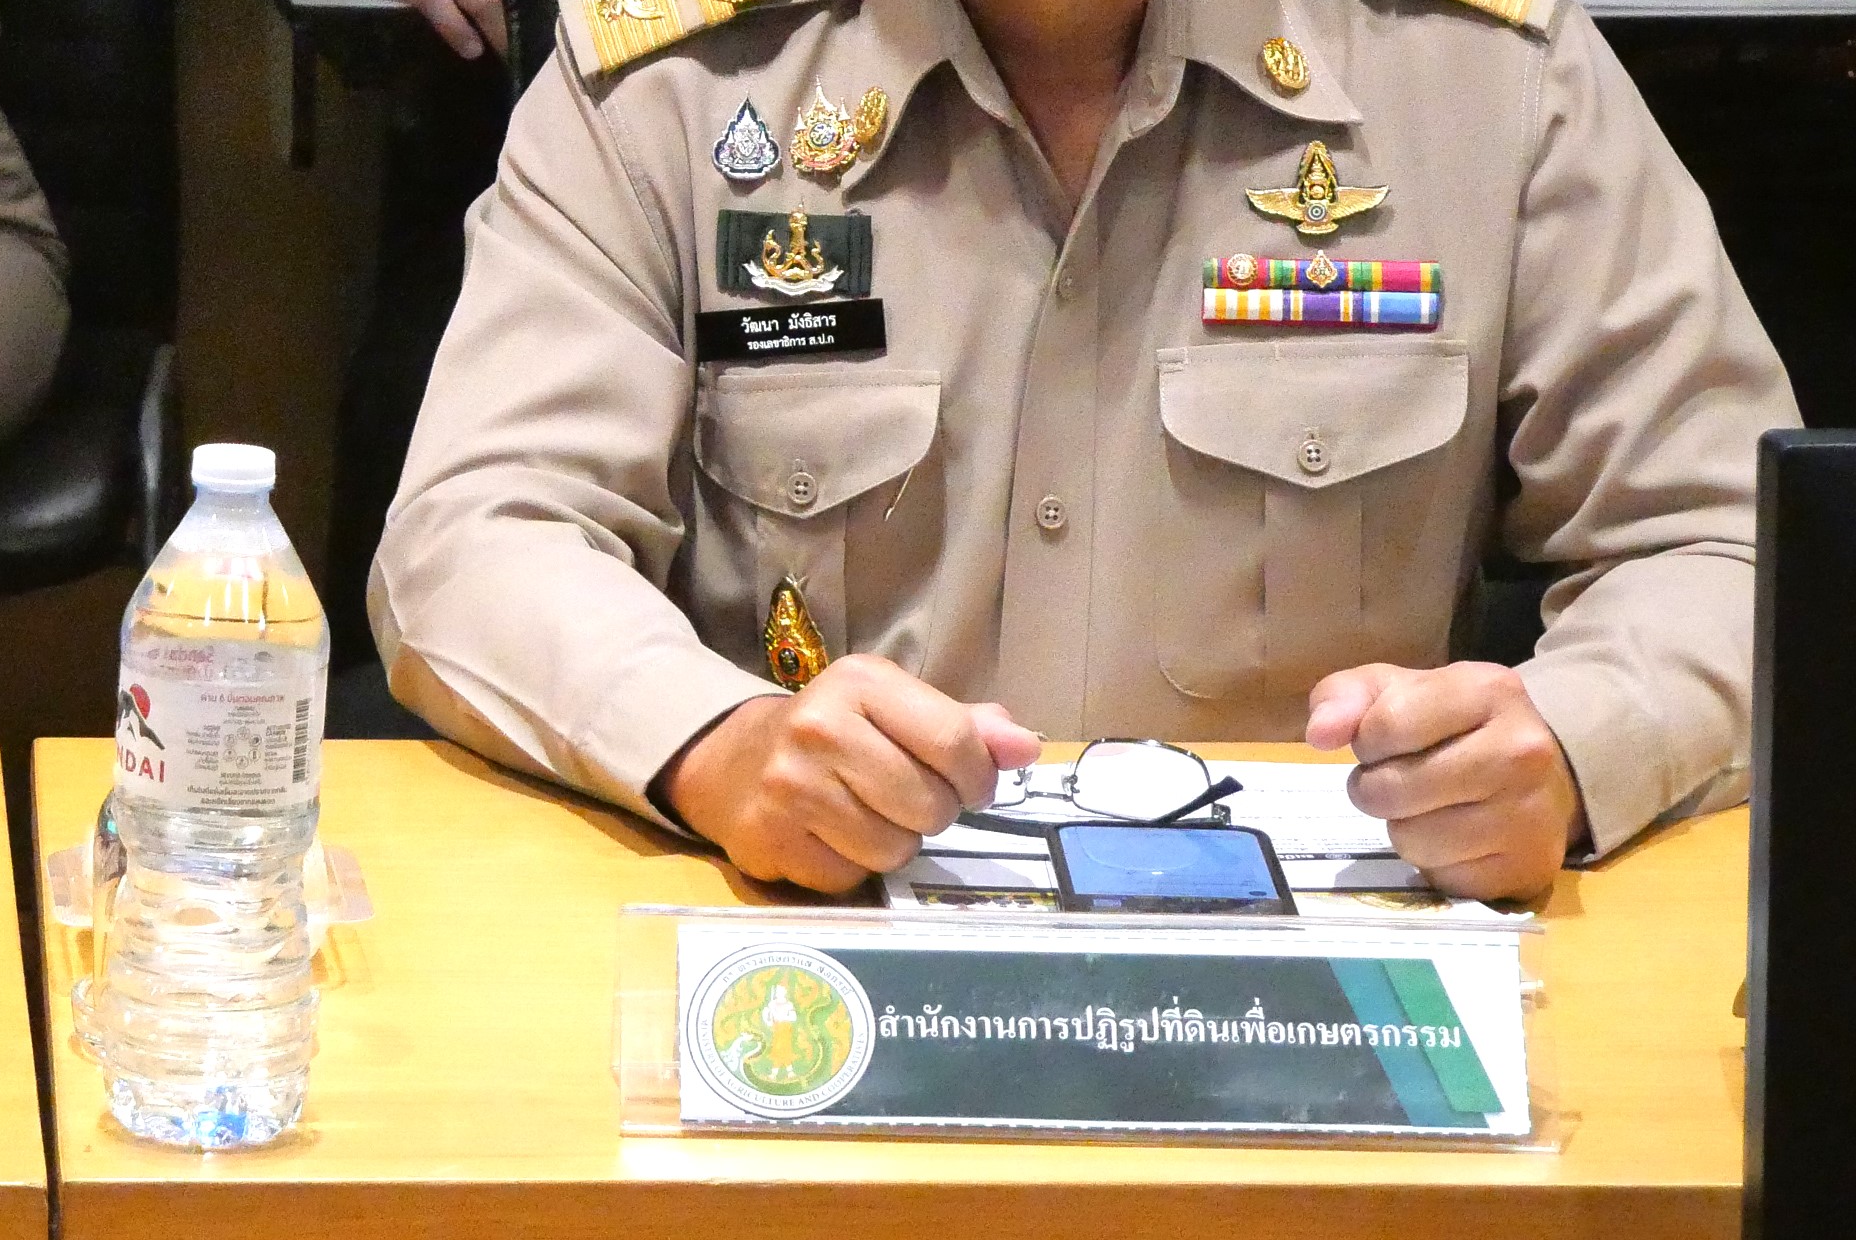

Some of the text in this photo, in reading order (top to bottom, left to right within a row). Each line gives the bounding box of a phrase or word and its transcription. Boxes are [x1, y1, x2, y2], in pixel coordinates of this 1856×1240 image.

[741, 312, 837, 333] วัฒนา มังธิสาร
[747, 335, 806, 350] รองเลขาธิการ
[878, 996, 1460, 1052] สำนักงานการปฏิรูปที่ดินเพื่อเกษตรกรรม
[798, 1092, 820, 1106] AND
